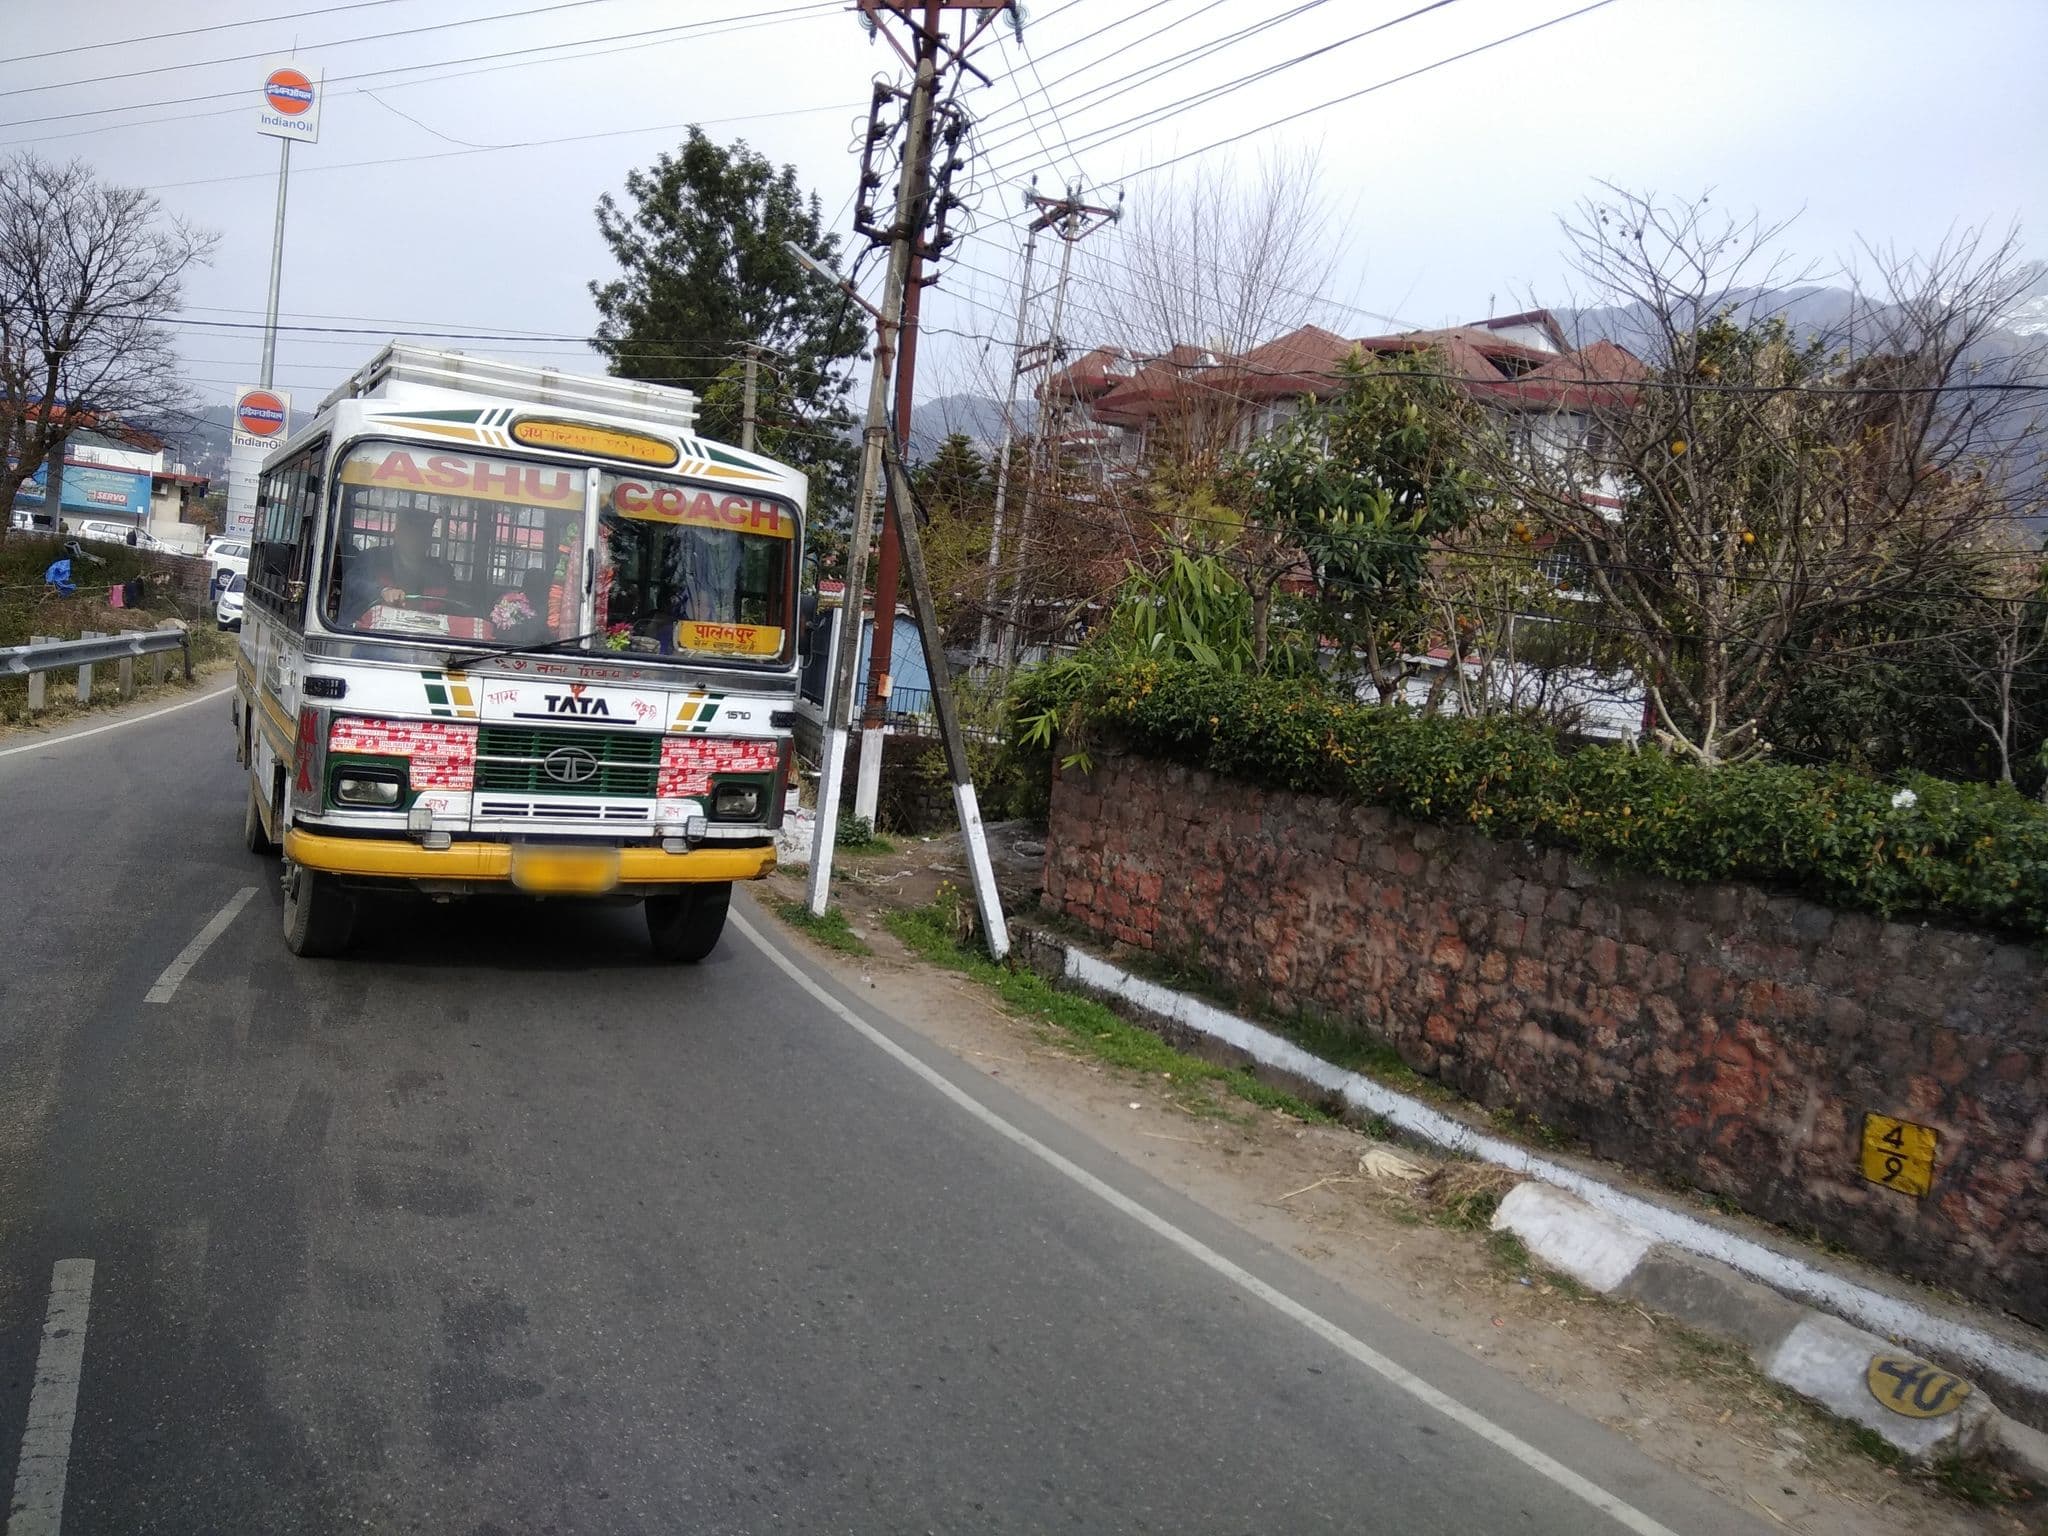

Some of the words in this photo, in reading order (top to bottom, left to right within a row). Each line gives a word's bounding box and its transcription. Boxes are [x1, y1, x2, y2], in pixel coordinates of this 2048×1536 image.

[261, 114, 313, 131] IndianOil
[97, 491, 126, 502] SERVO
[371, 450, 571, 501] ASHU
[614, 482, 779, 530] COACH
[544, 694, 609, 716] TATA
[1882, 1126, 1904, 1147] 4
[1882, 1157, 1904, 1182] 9
[1878, 1360, 1958, 1411] 40
